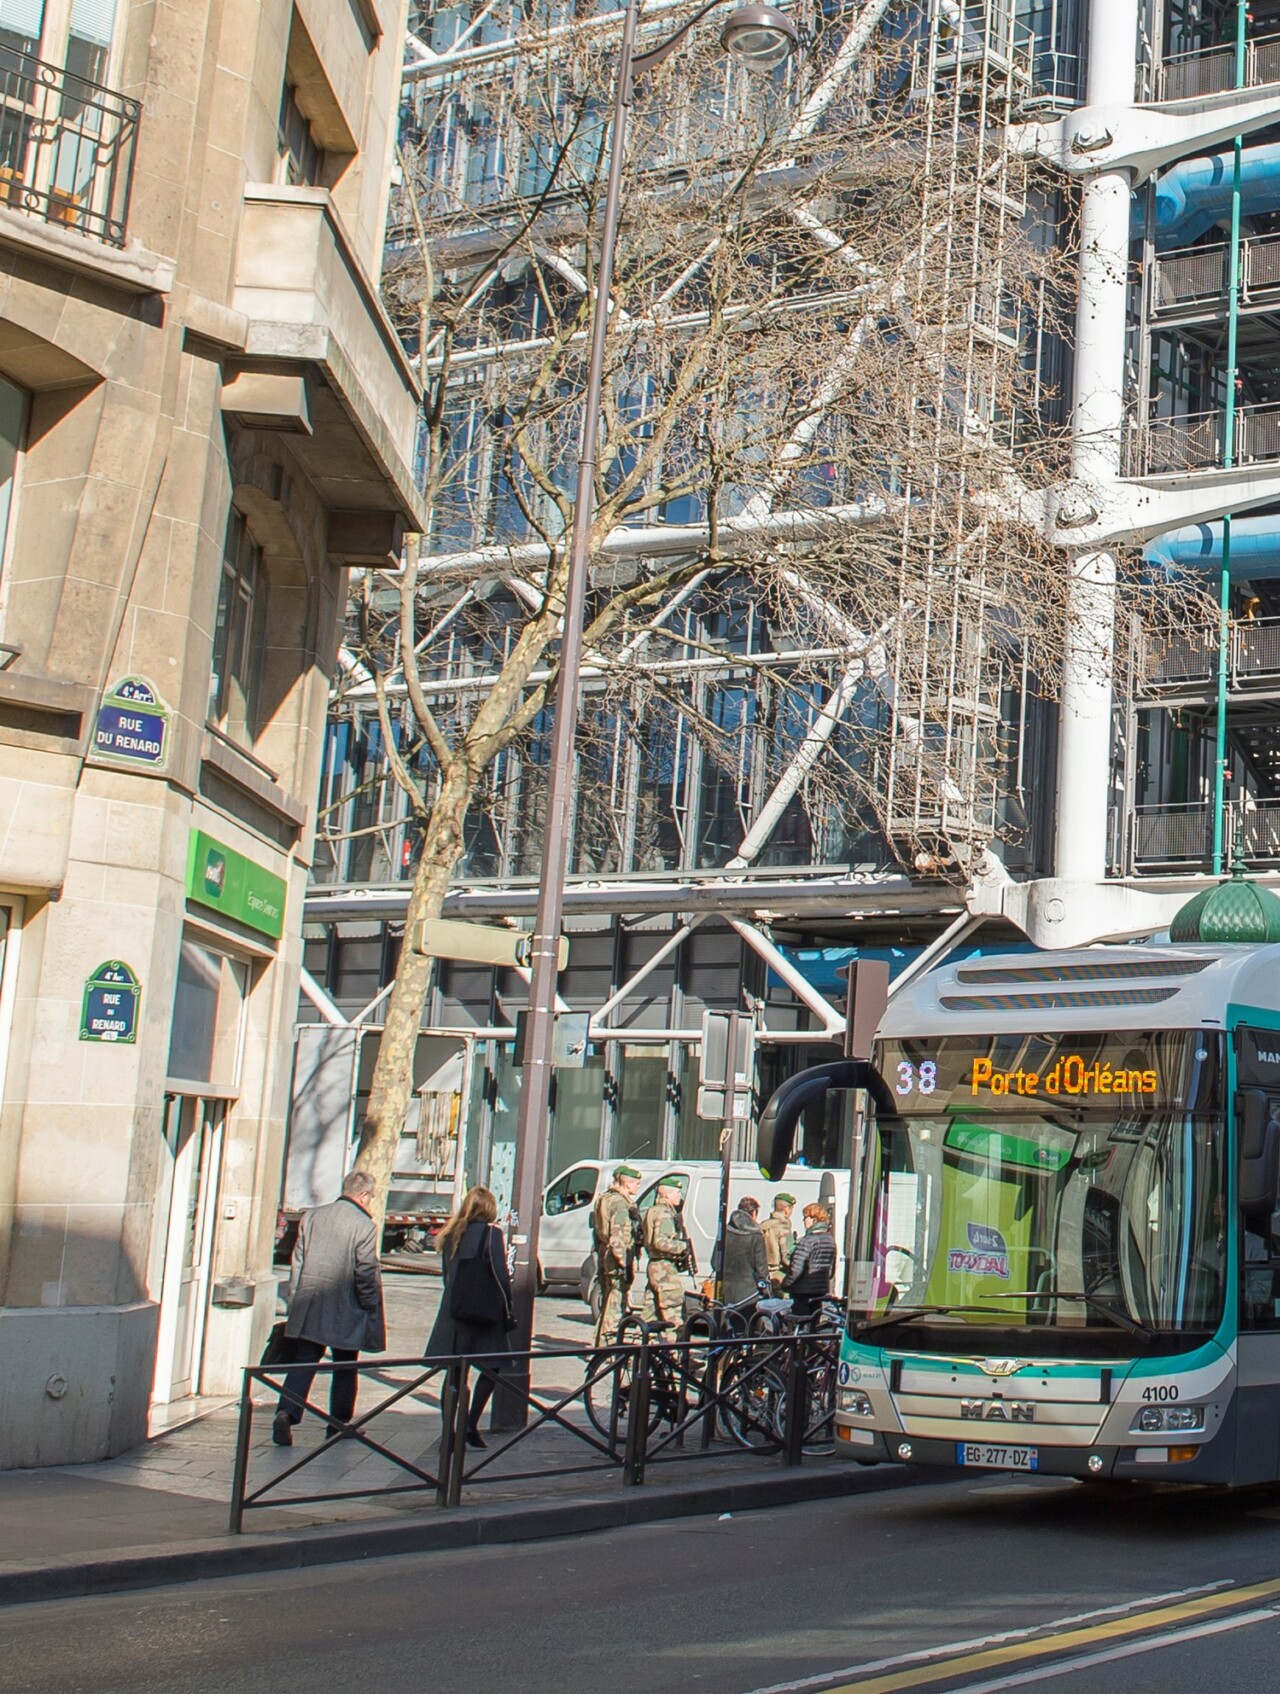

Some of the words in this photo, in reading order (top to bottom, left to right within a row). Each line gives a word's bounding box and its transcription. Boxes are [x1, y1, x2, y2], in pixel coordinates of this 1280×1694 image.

[118, 717, 143, 732] RUE
[97, 731, 113, 745] DU
[115, 735, 160, 754] RENARD
[103, 993, 121, 1005] RUE
[92, 1019, 126, 1031] RENARD
[896, 1060, 937, 1095] 38
[971, 1058, 1038, 1096] Porte
[1045, 1055, 1157, 1095] d'Orléans
[1142, 1385, 1179, 1401] 4100
[961, 1398, 1037, 1421] MAN
[966, 1447, 1028, 1466] EG-277-DZ
